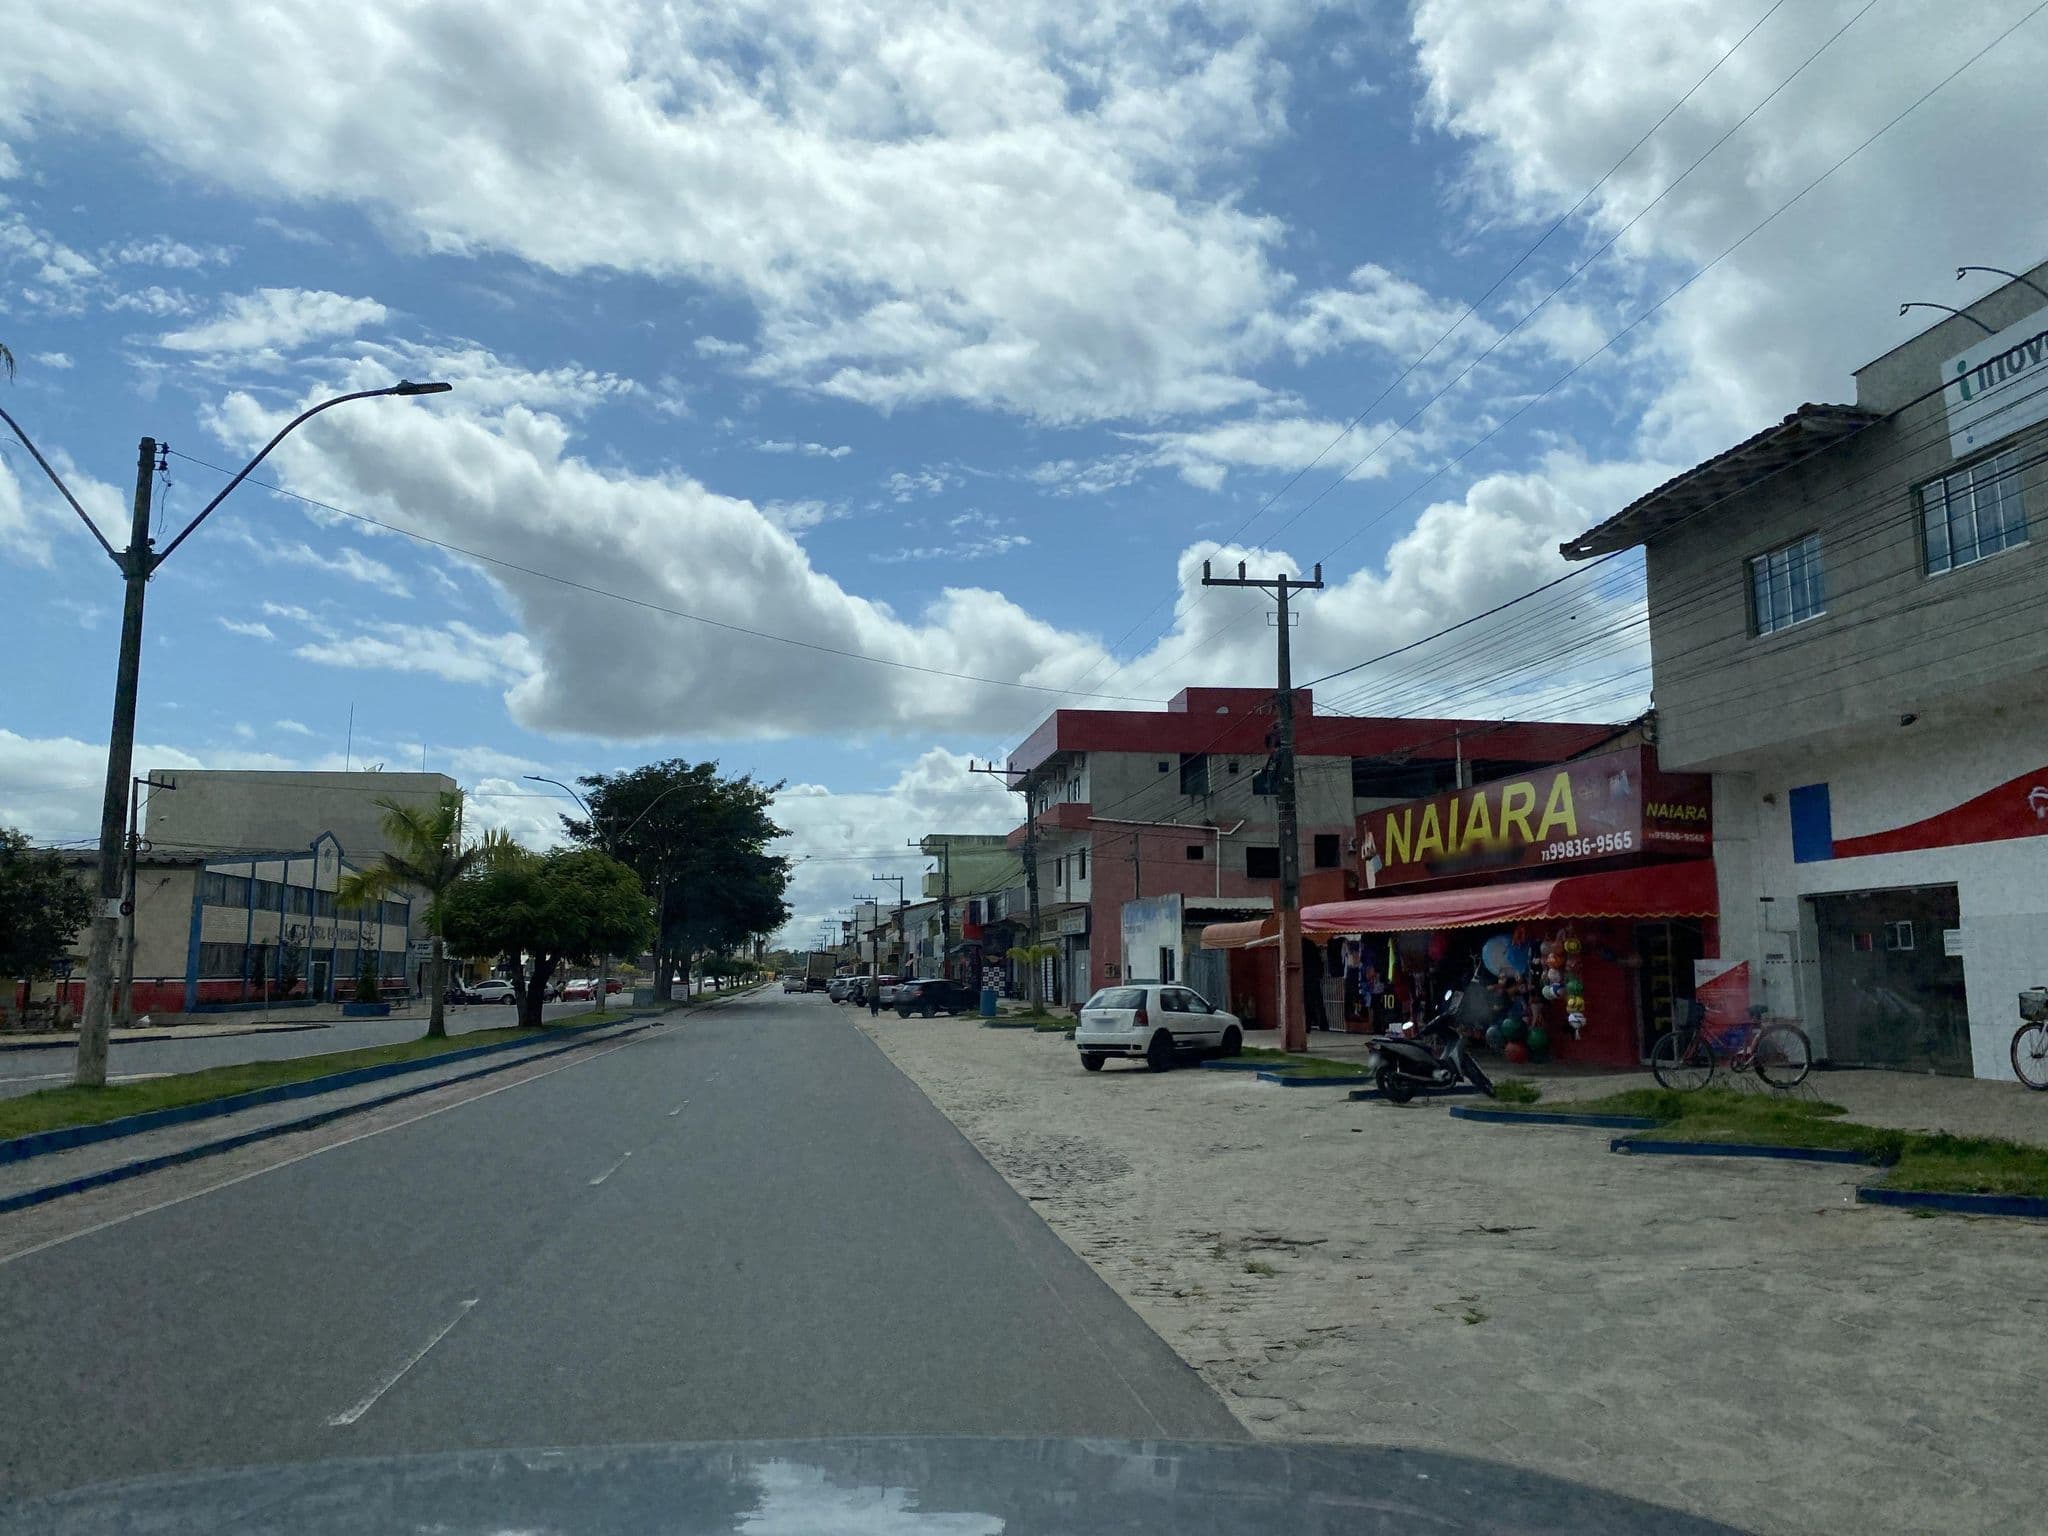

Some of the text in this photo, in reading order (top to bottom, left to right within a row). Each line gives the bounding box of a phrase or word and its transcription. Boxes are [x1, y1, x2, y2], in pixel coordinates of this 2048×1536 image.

[1385, 771, 1578, 866] NAIARA
[1646, 801, 1707, 821] NAIARA
[1383, 994, 1395, 1009] 10
